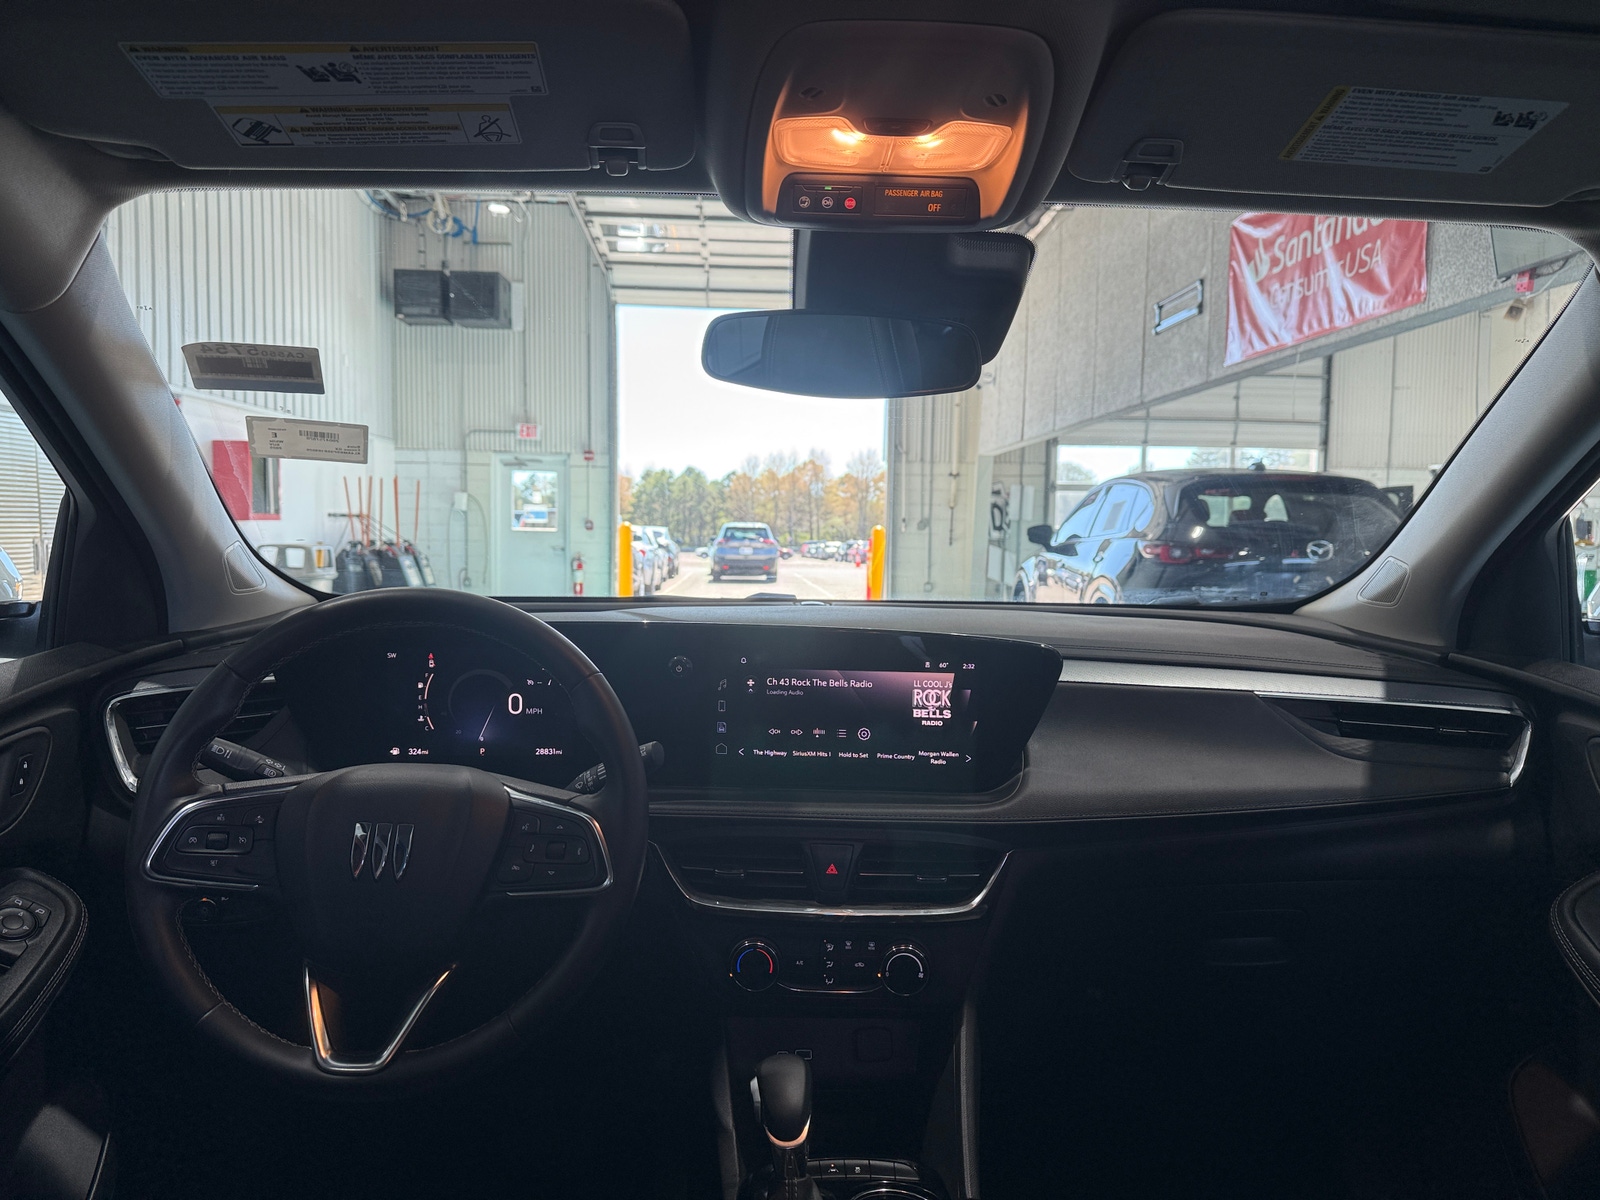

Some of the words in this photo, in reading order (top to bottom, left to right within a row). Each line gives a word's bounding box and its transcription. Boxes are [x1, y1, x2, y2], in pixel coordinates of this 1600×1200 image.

[1396, 90, 1441, 99] ADVANCED
[1447, 133, 1498, 141] INTELLIGENTS
[884, 189, 919, 197] PASSENGER
[927, 203, 942, 212] OFF
[1345, 239, 1382, 278] USA
[519, 424, 537, 438] EXIT
[766, 677, 778, 686] Ch
[779, 678, 790, 686] 43
[791, 678, 811, 687] Rock
[812, 678, 828, 687] The
[829, 679, 848, 688] Bells
[850, 680, 873, 688] Radio
[922, 680, 943, 688] COOL
[912, 688, 951, 708] ROCK
[508, 692, 523, 715] 0
[525, 707, 543, 715] MPH
[912, 708, 952, 719] BELLS
[479, 747, 485, 755] P
[893, 753, 915, 761] Country
